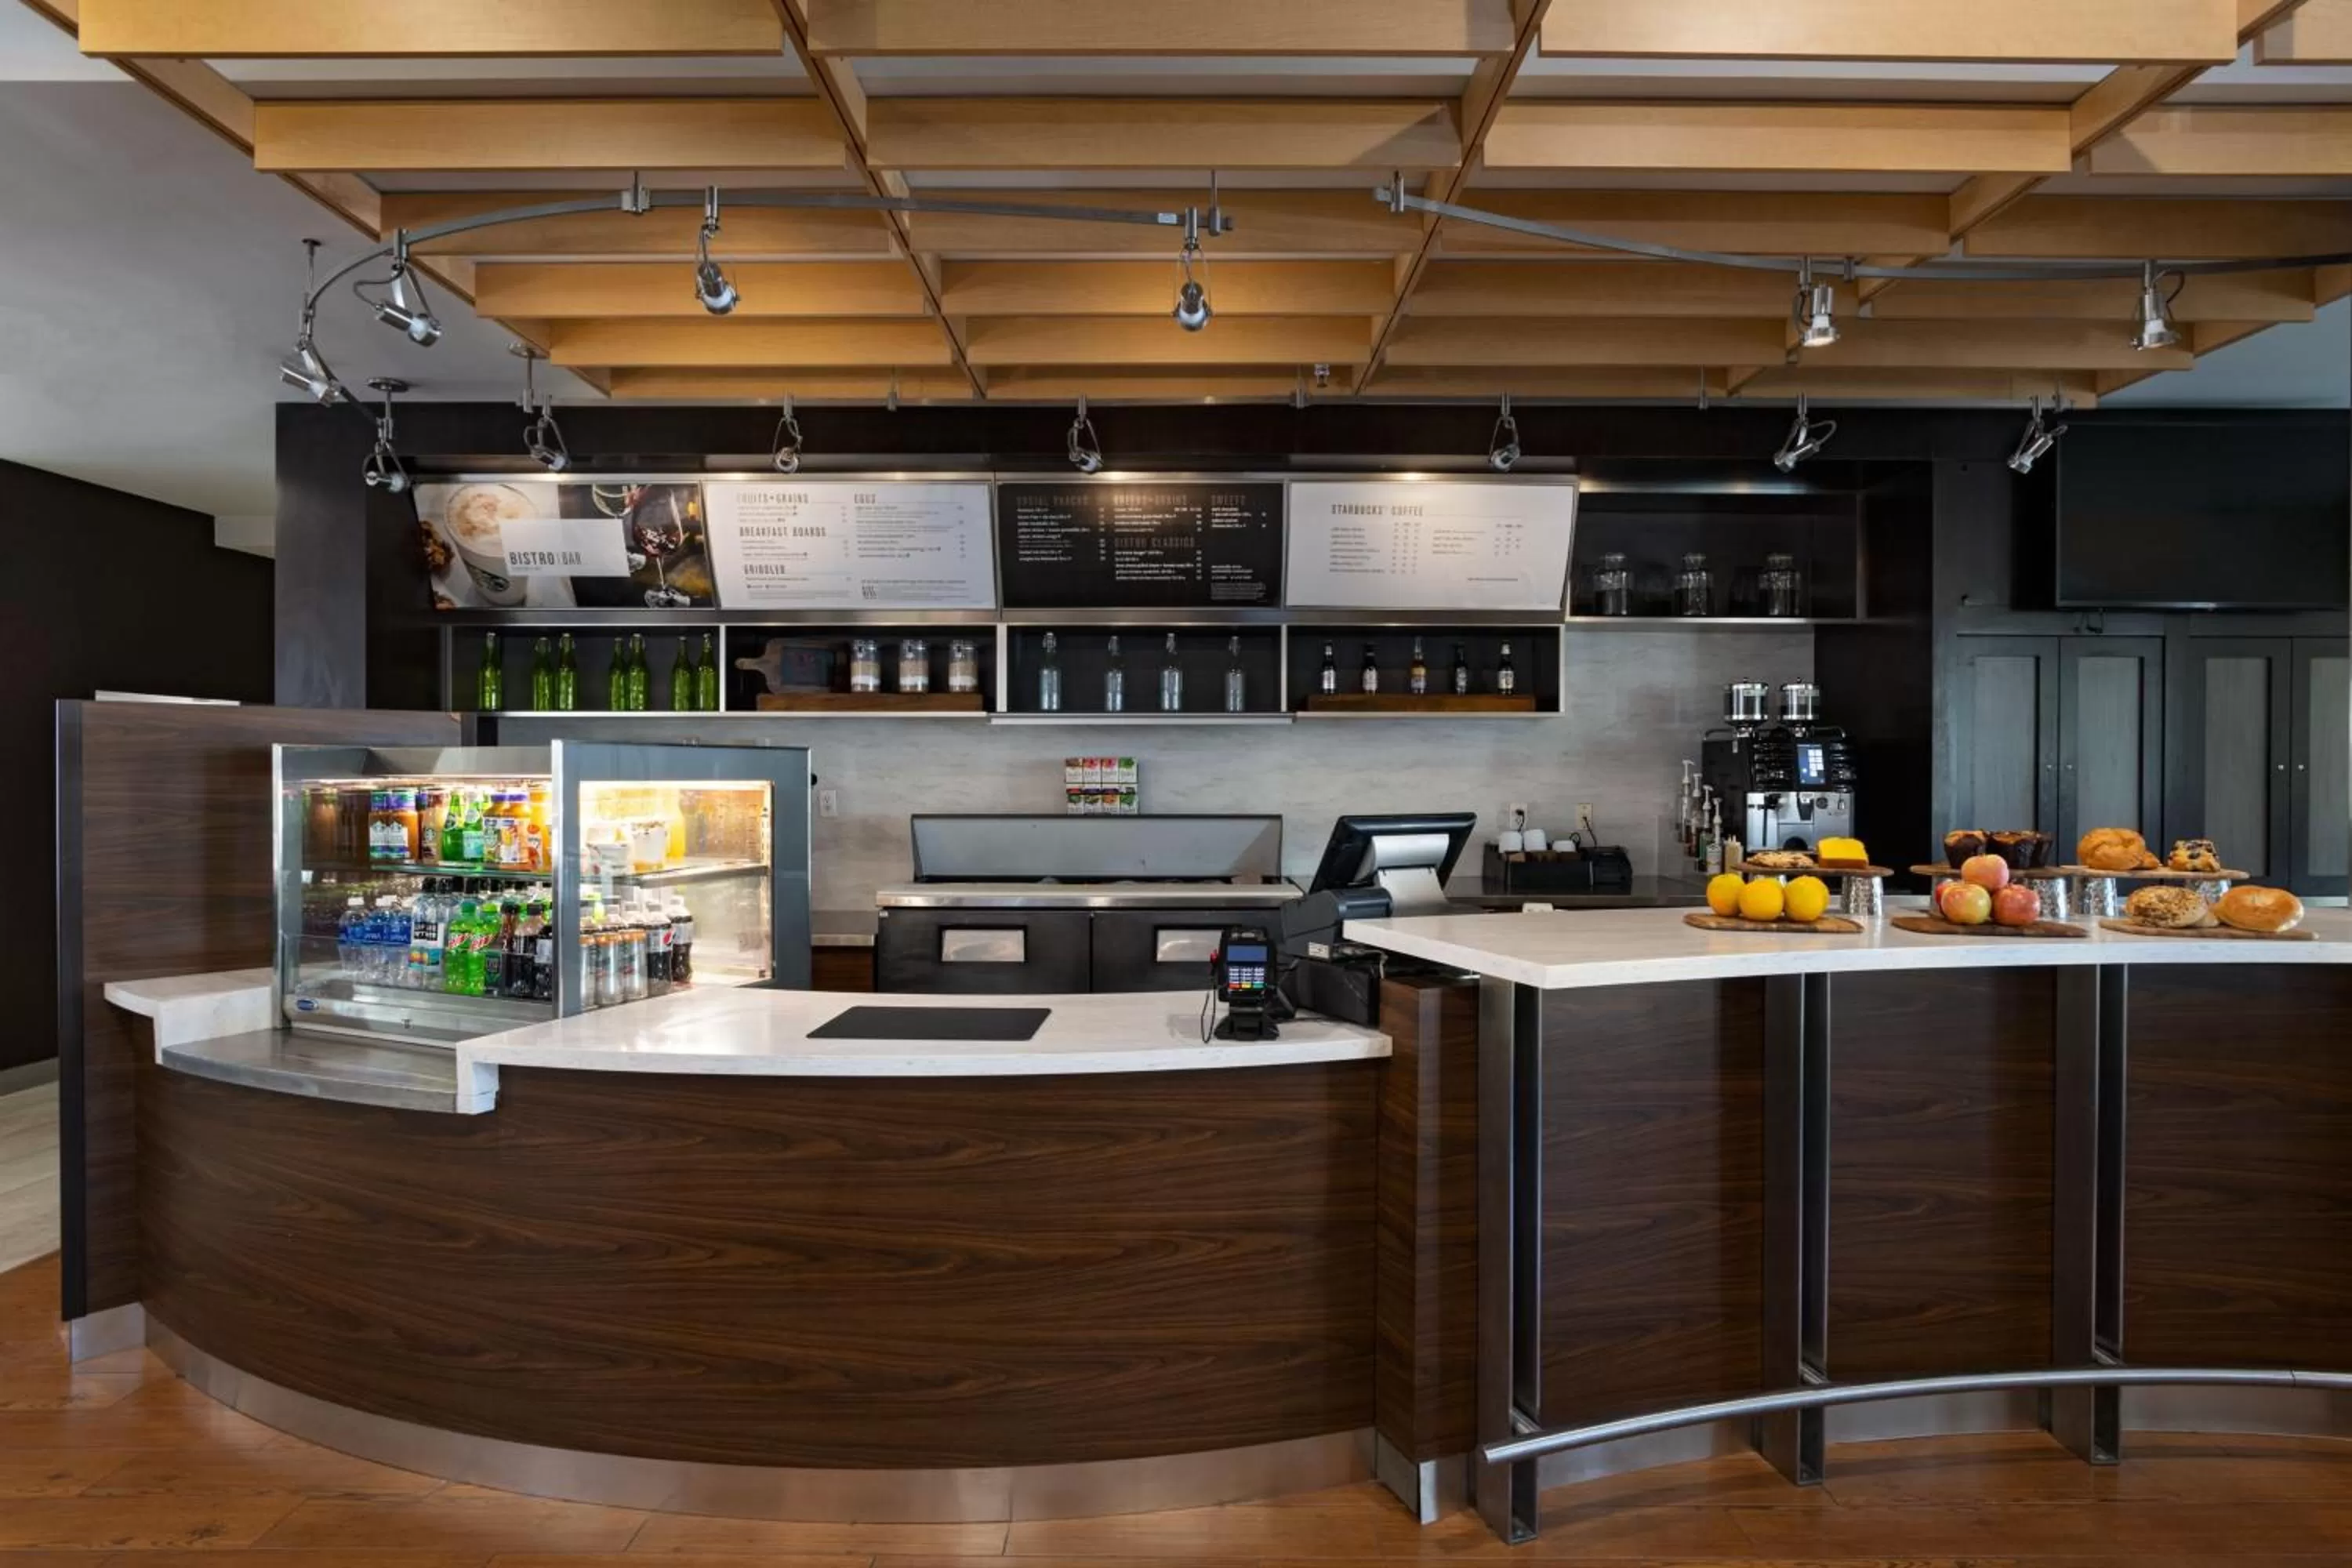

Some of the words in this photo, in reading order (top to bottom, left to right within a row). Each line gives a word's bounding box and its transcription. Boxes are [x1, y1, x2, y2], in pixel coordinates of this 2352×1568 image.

[1391, 505, 1424, 517] COFFEE
[739, 526, 787, 537] BREAKFAST
[792, 526, 826, 537] BOARDS
[1150, 537, 1195, 548] CLASSICS
[509, 551, 555, 565] BISTRO
[561, 551, 583, 565] BAR
